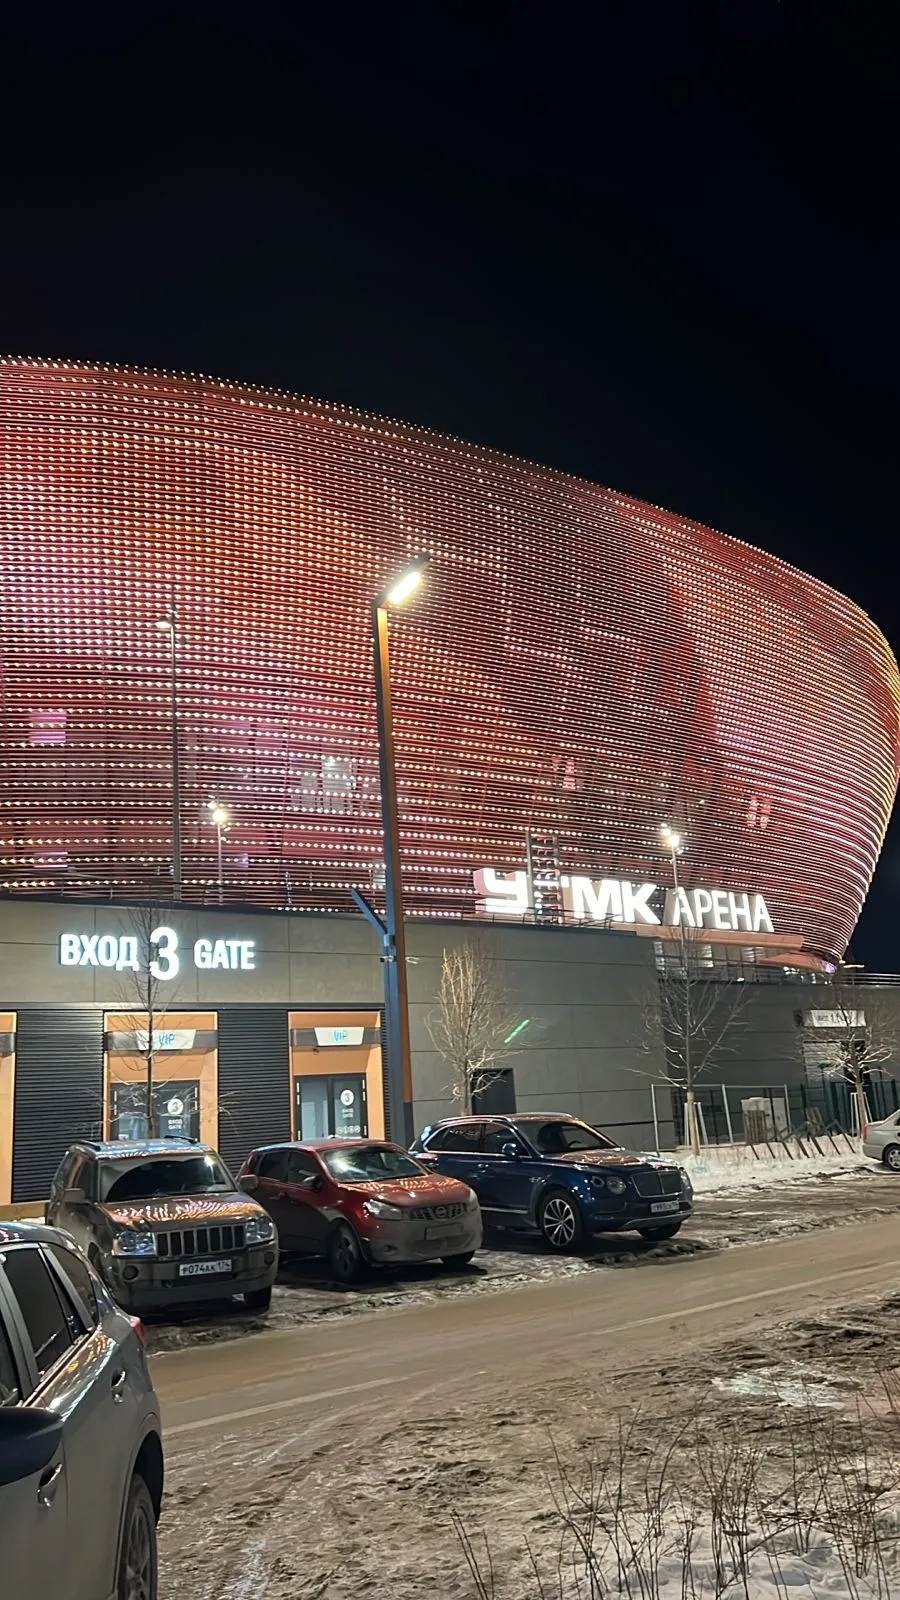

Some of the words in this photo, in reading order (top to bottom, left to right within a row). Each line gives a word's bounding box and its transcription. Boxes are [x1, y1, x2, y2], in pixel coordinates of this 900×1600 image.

[671, 886, 775, 933] АРЕНА
[59, 933, 140, 972] ВХОД
[149, 926, 180, 981] 3
[193, 939, 256, 970] GATE
[158, 1032, 176, 1046] VIP
[333, 1030, 349, 1042] VIP
